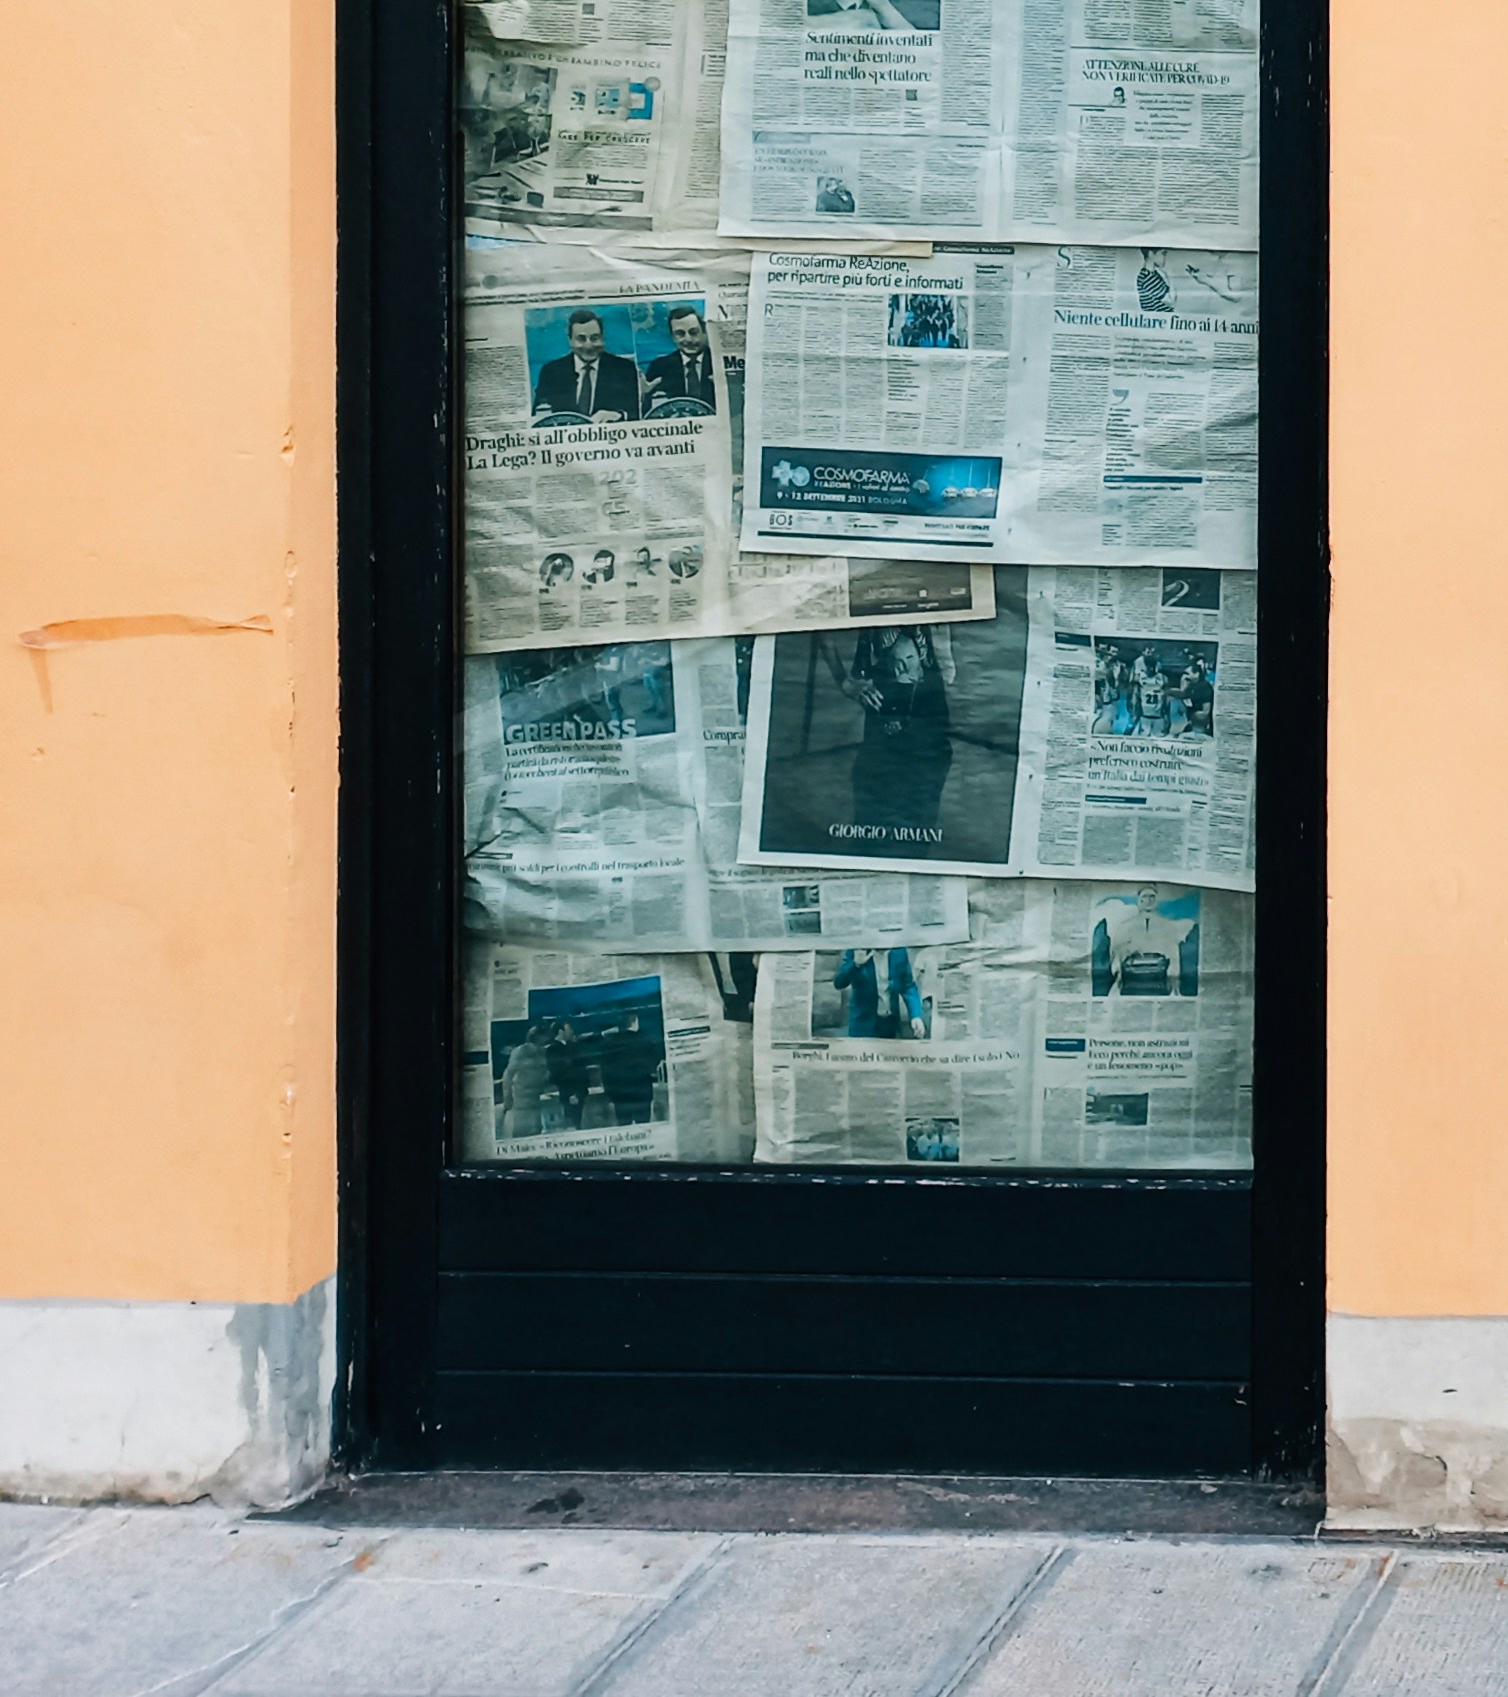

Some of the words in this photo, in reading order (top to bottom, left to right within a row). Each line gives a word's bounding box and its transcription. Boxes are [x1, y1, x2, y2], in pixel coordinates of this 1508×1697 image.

[806, 32, 874, 46] Sentimenti
[876, 33, 932, 47] inventati
[805, 51, 826, 62] ma
[828, 49, 850, 63] che
[852, 51, 916, 64] diventano
[804, 67, 832, 80] reali
[835, 68, 866, 80] nello
[868, 69, 932, 84] spettatore
[769, 253, 847, 269] Cosmofarma
[850, 257, 910, 273] ReAzione,
[768, 271, 788, 283] per
[791, 271, 840, 287] ripartire
[843, 273, 862, 288] più
[866, 273, 891, 287] forti
[895, 278, 902, 287] e
[905, 276, 963, 290] informati
[1054, 310, 1102, 326] Niente
[1105, 312, 1167, 329] cellulare
[1170, 317, 1197, 331] fino
[1199, 319, 1211, 331] ai
[1230, 322, 1259, 334] anni
[466, 435, 525, 452] Draghi:
[544, 427, 627, 445] all'obbligo
[632, 421, 703, 438] vaccinale
[467, 455, 487, 470] La
[492, 451, 536, 469] Lega?
[541, 451, 552, 465] Il
[556, 448, 620, 466] governo
[625, 447, 643, 458] va
[647, 440, 695, 457] avanti
[814, 466, 910, 485] COSMOFARMA
[506, 721, 576, 743] GREEN
[580, 719, 637, 740] PASS
[829, 824, 886, 839] GIORGIO
[890, 827, 943, 843] ARMANI
